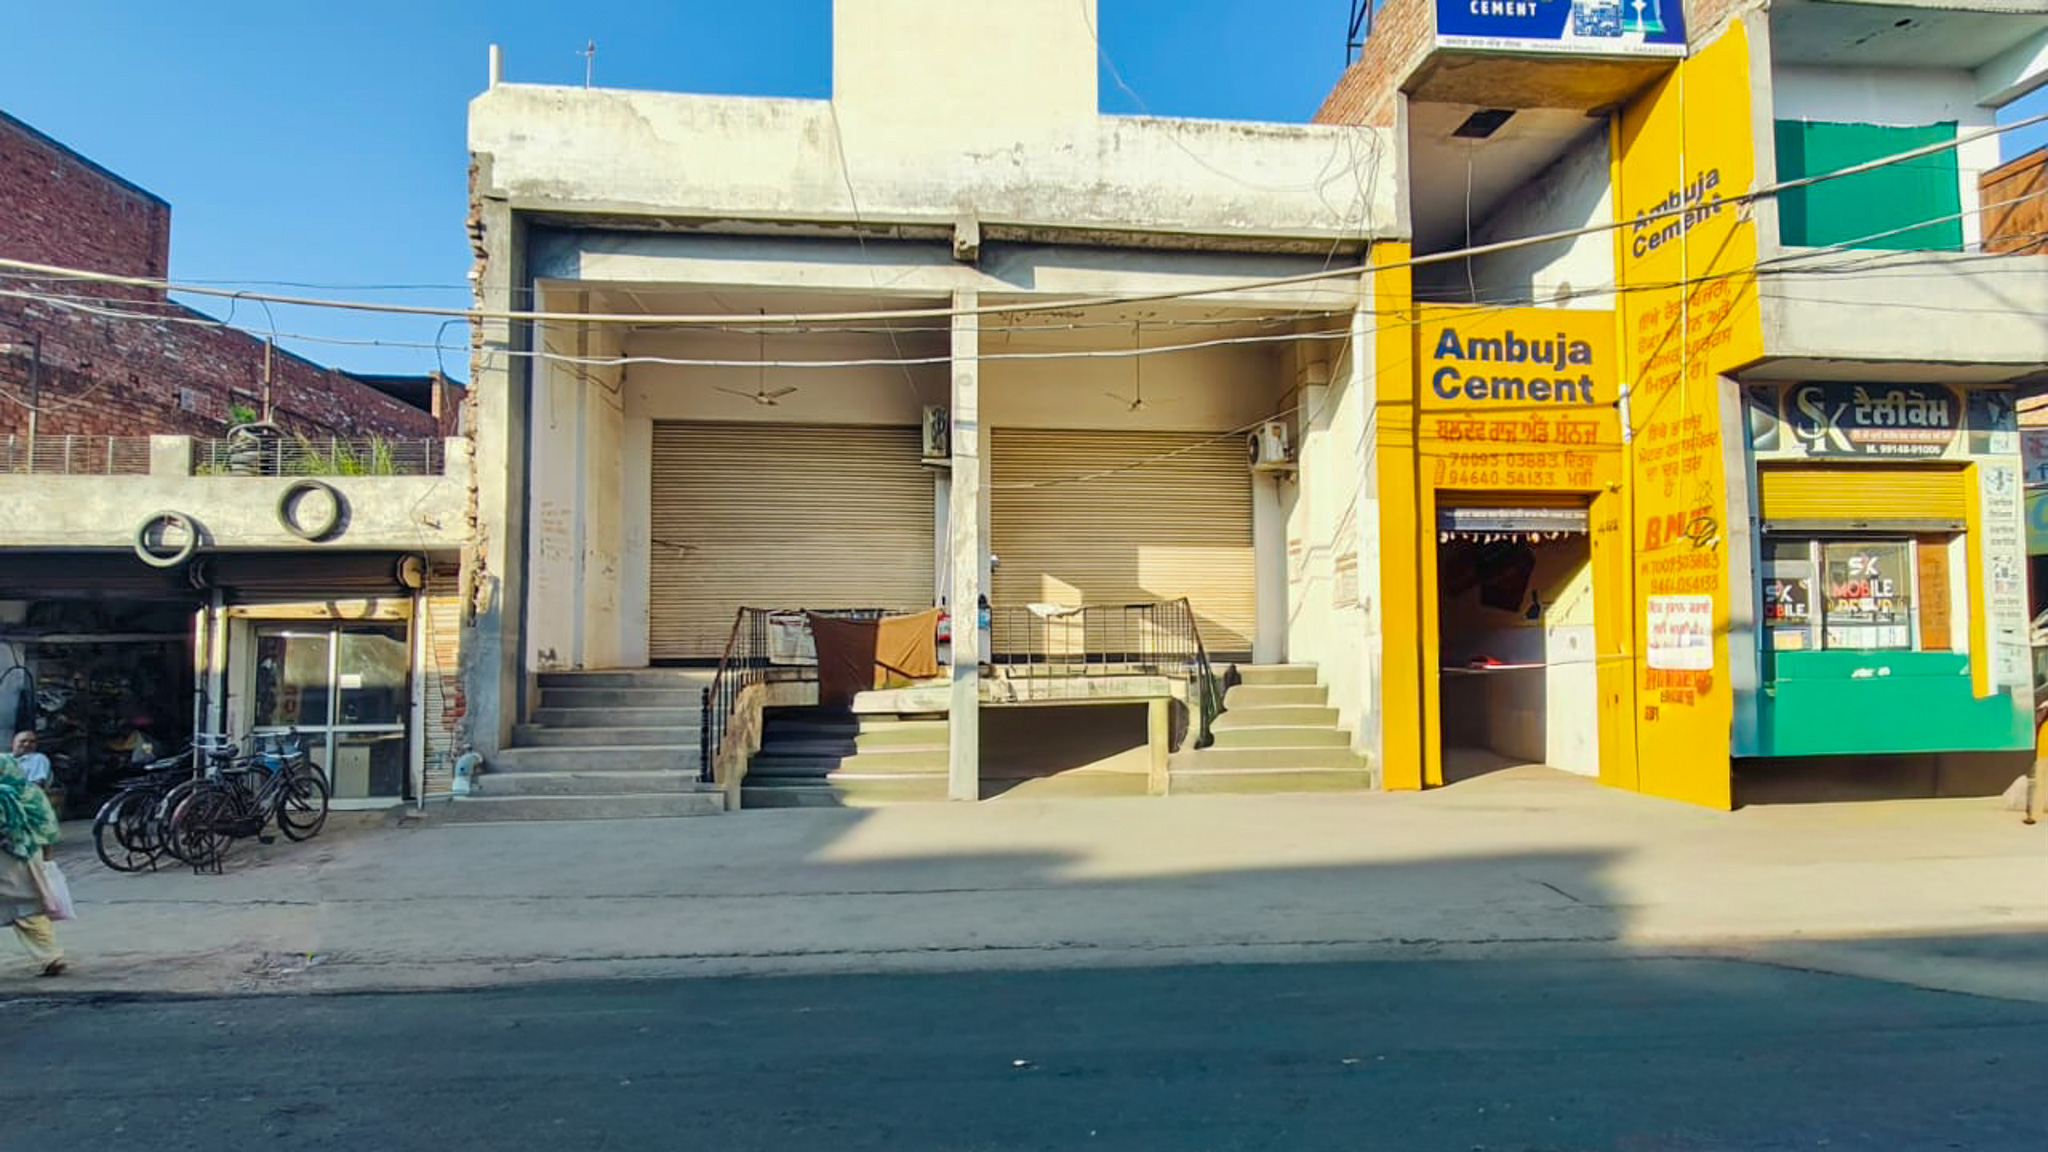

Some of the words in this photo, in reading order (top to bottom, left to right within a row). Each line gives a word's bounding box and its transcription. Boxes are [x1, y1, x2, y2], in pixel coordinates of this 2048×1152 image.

[1470, 1, 1537, 17] CEMENT
[1633, 168, 1720, 232] Ambuja
[1632, 193, 1722, 258] Cement
[1433, 328, 1593, 371] Ambuja
[1433, 366, 1594, 404] Cement
[1797, 386, 1856, 453] SK
[1449, 470, 1499, 485] 94640
[1506, 471, 1553, 485] 54133
[1848, 555, 1879, 575] SK
[1832, 578, 1894, 598] MOBILE
[1766, 603, 1806, 618] OBILE
